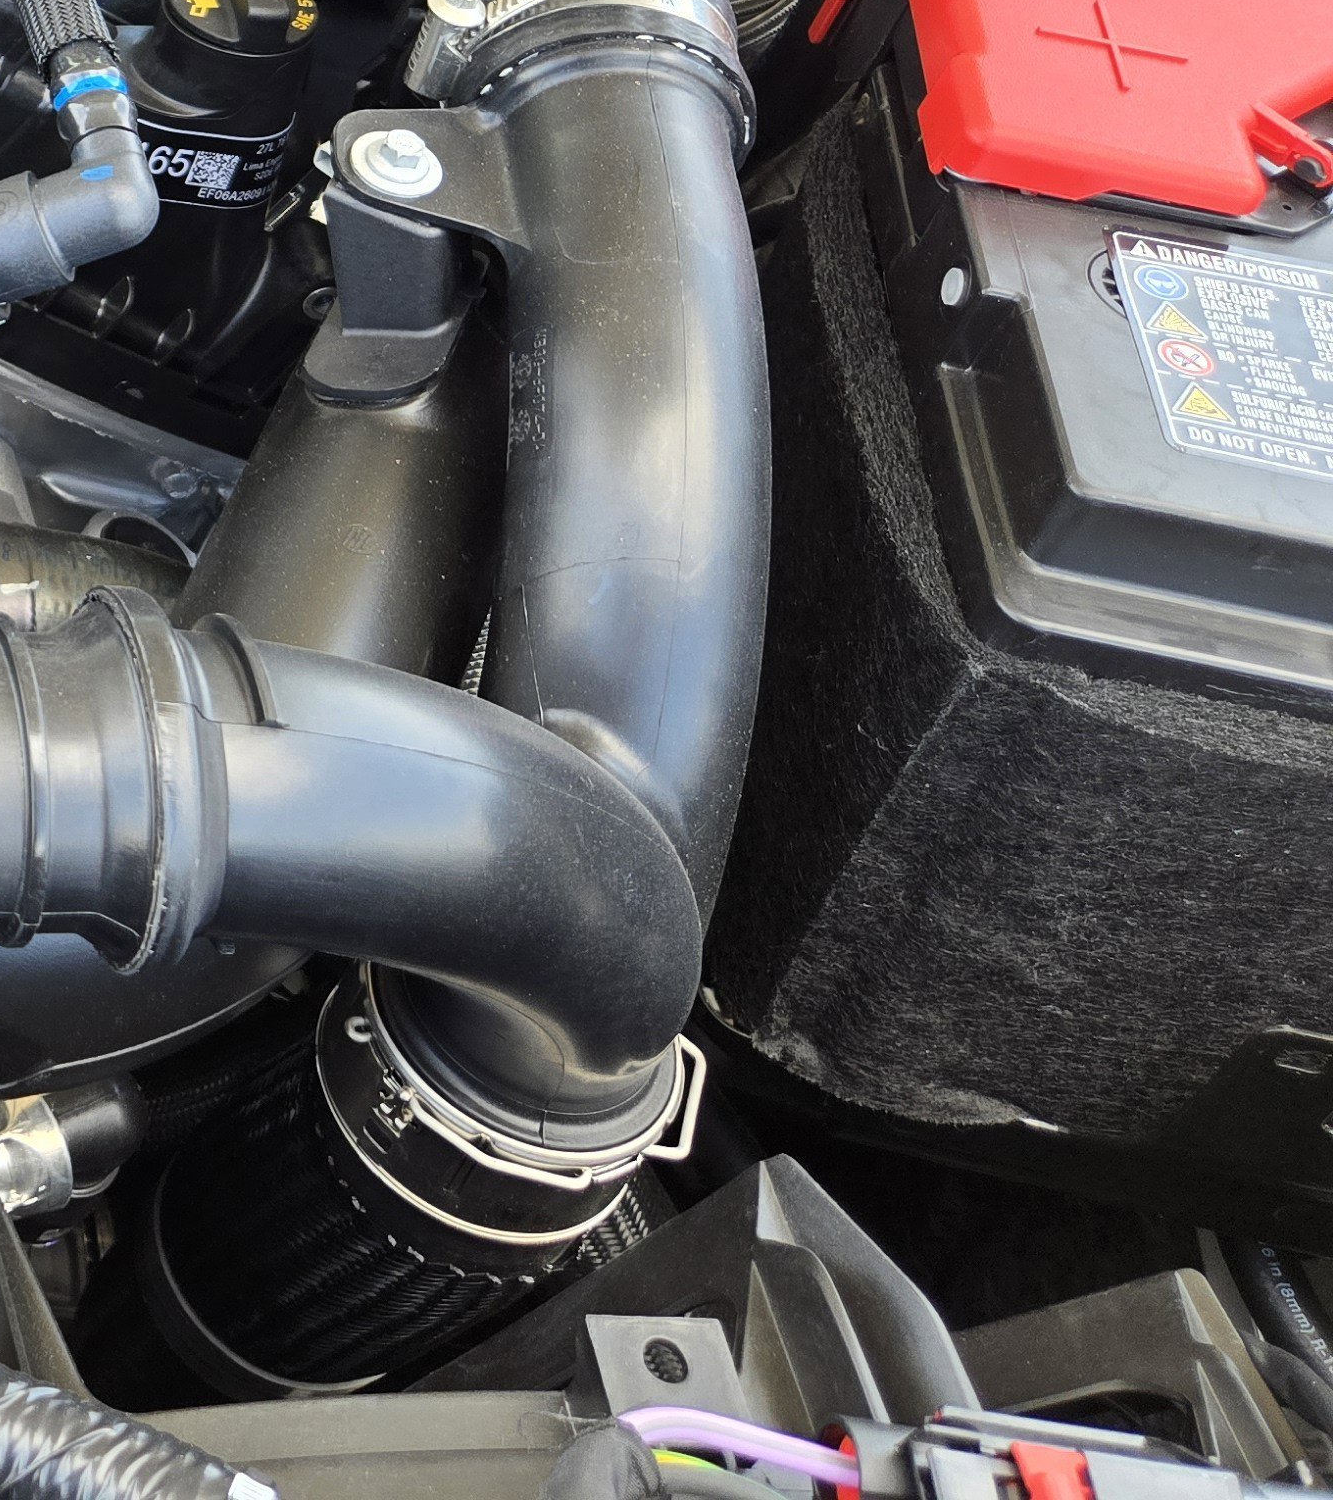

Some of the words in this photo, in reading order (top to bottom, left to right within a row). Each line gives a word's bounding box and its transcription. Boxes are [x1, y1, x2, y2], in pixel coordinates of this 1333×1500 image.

[291, 10, 315, 31] SAE
[141, 140, 195, 178] 65
[1156, 244, 1321, 290] DANGER/POISON
[1193, 275, 1240, 294] SHIELD
[1197, 287, 1270, 311] EXPLOSIVE
[1204, 309, 1245, 326] CAUSE
[1305, 317, 1333, 332] EXP
[1208, 320, 1276, 341] BLINDNESS
[1211, 330, 1230, 343] OR
[1217, 349, 1237, 364] NO
[1246, 354, 1293, 373] SPARKS
[1250, 365, 1298, 384] FLAMES
[1253, 377, 1308, 397] SMOKING
[1230, 390, 1288, 414] SULFURIC
[1289, 401, 1318, 419] ACID
[1235, 404, 1274, 421] CAUSE
[1186, 426, 1216, 445] DO
[1218, 433, 1256, 453] NOT
[1239, 416, 1259, 429] OR
[1259, 420, 1303, 440] SEVERE
[1303, 429, 1333, 445] BURN
